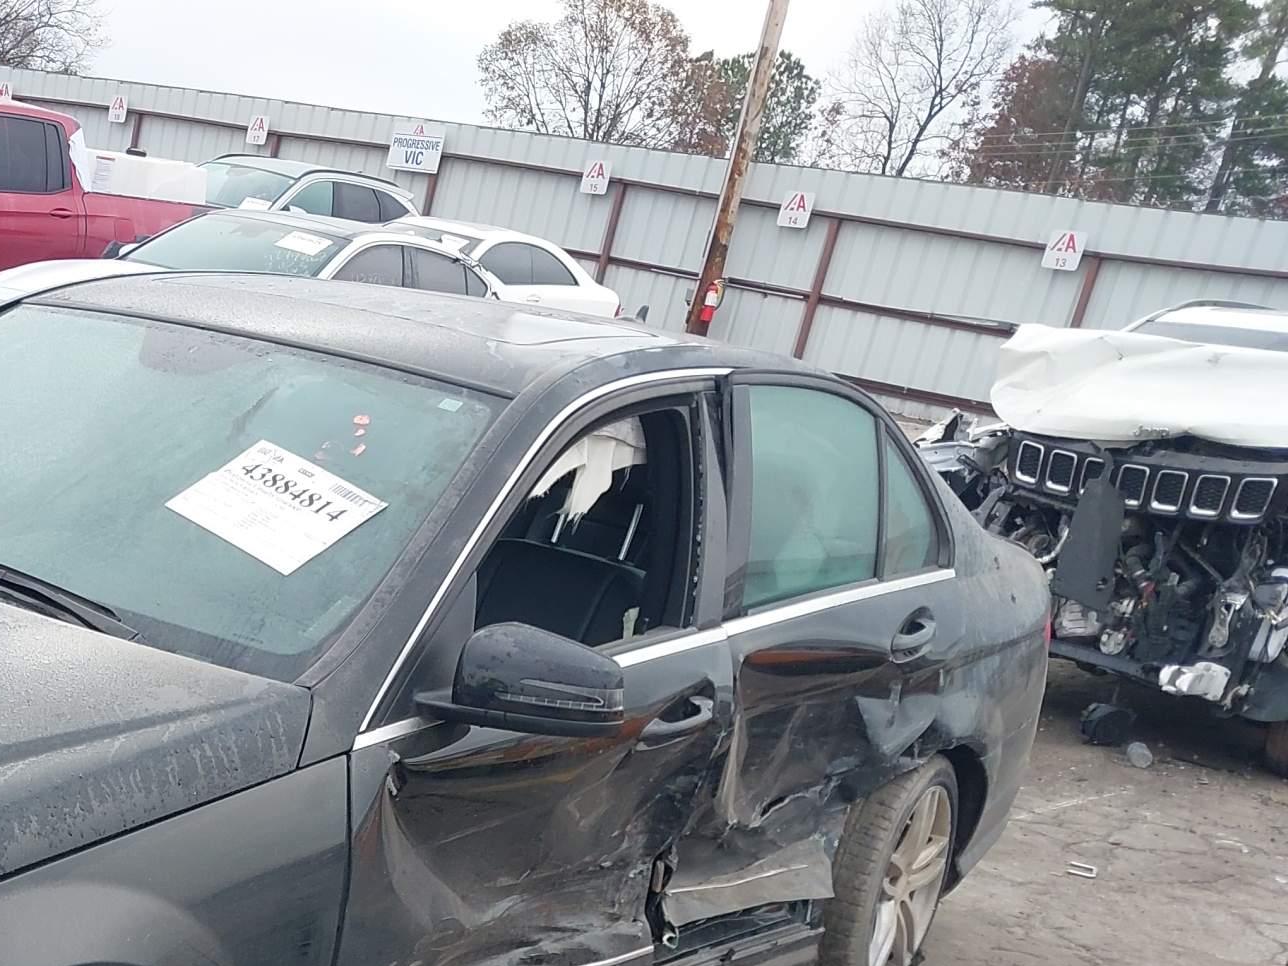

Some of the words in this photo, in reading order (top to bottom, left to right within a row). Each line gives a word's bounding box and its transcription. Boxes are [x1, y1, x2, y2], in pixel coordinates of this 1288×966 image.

[393, 137, 440, 151] PROGRESSIVE
[404, 150, 424, 165] VIC
[589, 183, 599, 192] 15
[788, 216, 799, 225] 14
[1055, 257, 1067, 268] 13
[242, 463, 348, 522] 43884814
